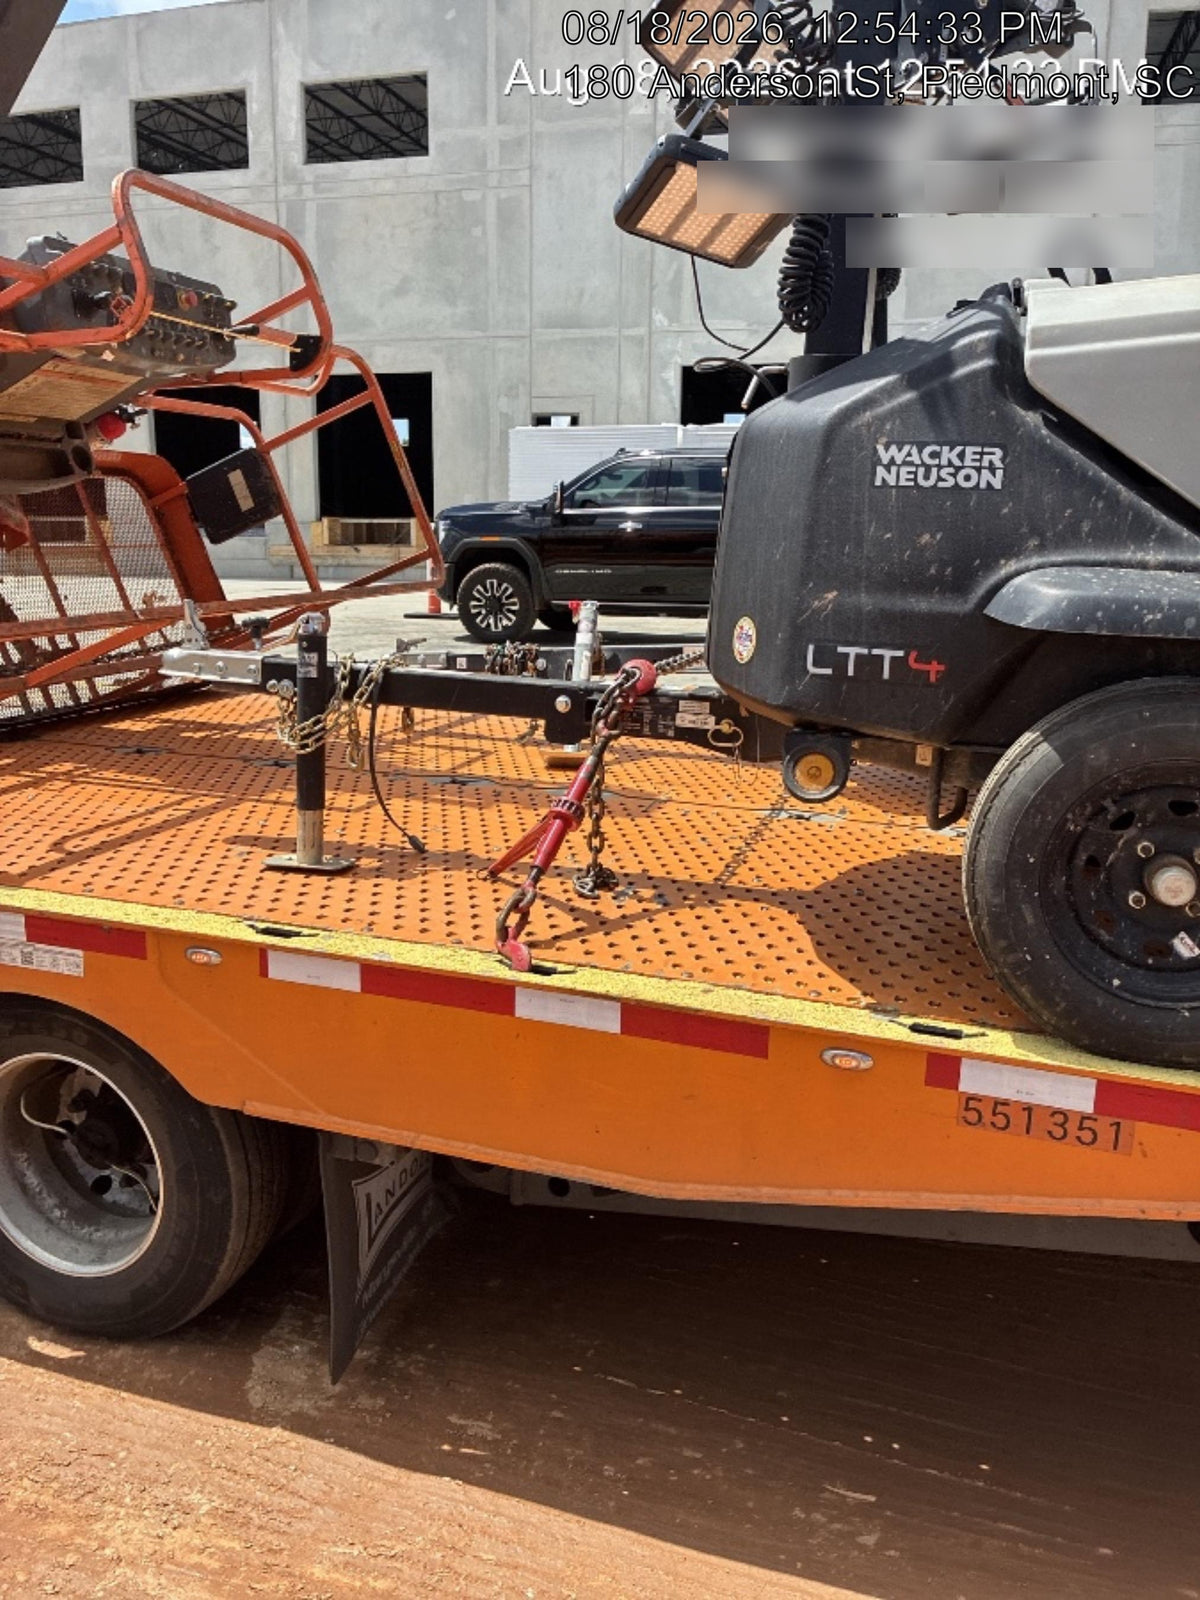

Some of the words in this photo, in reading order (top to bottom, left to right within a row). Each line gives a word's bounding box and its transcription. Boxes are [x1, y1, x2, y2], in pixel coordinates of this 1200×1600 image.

[876, 444, 1005, 468] WACKER
[874, 465, 1004, 490] NEUSON
[806, 644, 945, 684] LTT4
[961, 1096, 1122, 1151] 551351
[365, 1156, 429, 1254] LANDO
